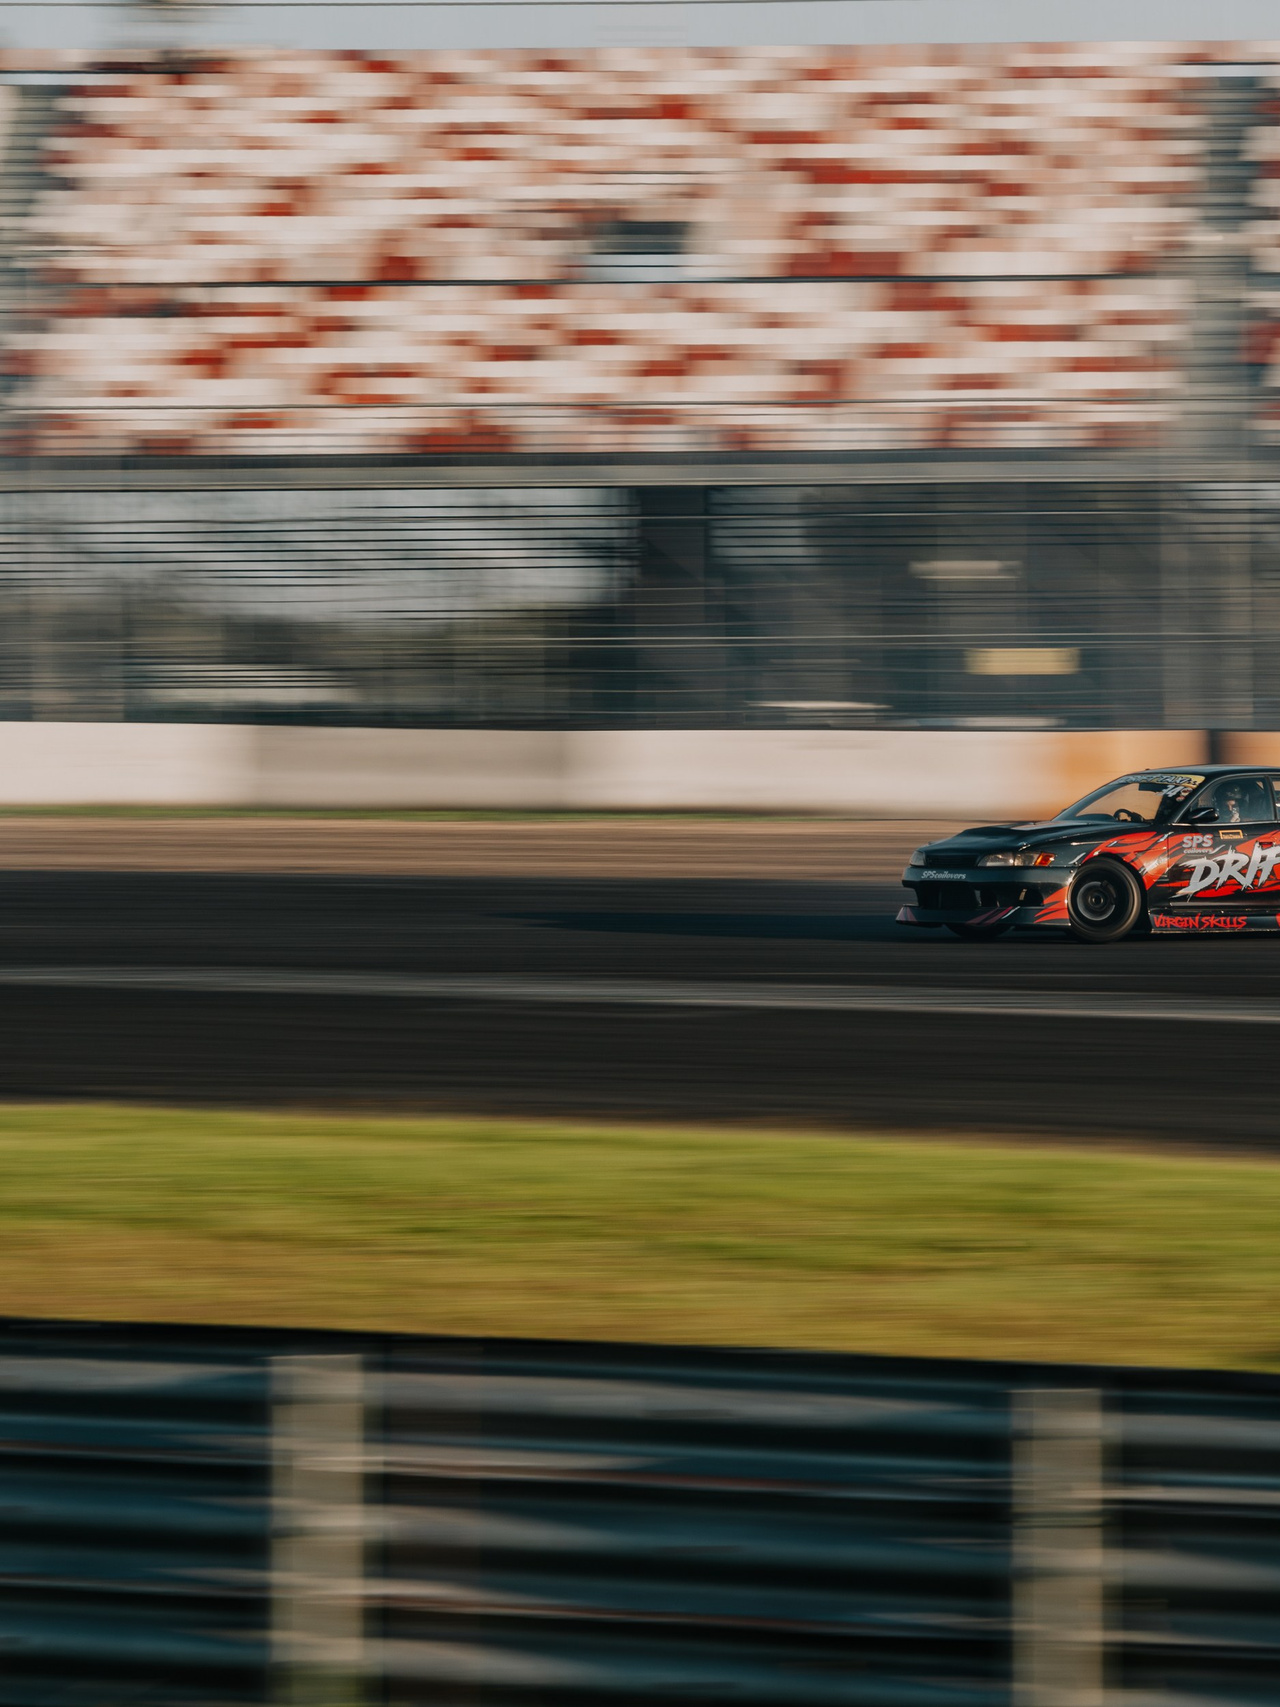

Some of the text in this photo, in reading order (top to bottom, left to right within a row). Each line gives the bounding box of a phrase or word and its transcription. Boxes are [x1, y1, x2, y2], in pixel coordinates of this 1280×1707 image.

[1182, 834, 1213, 848] SPS
[1154, 913, 1248, 930] VIRGIN SKILLS
